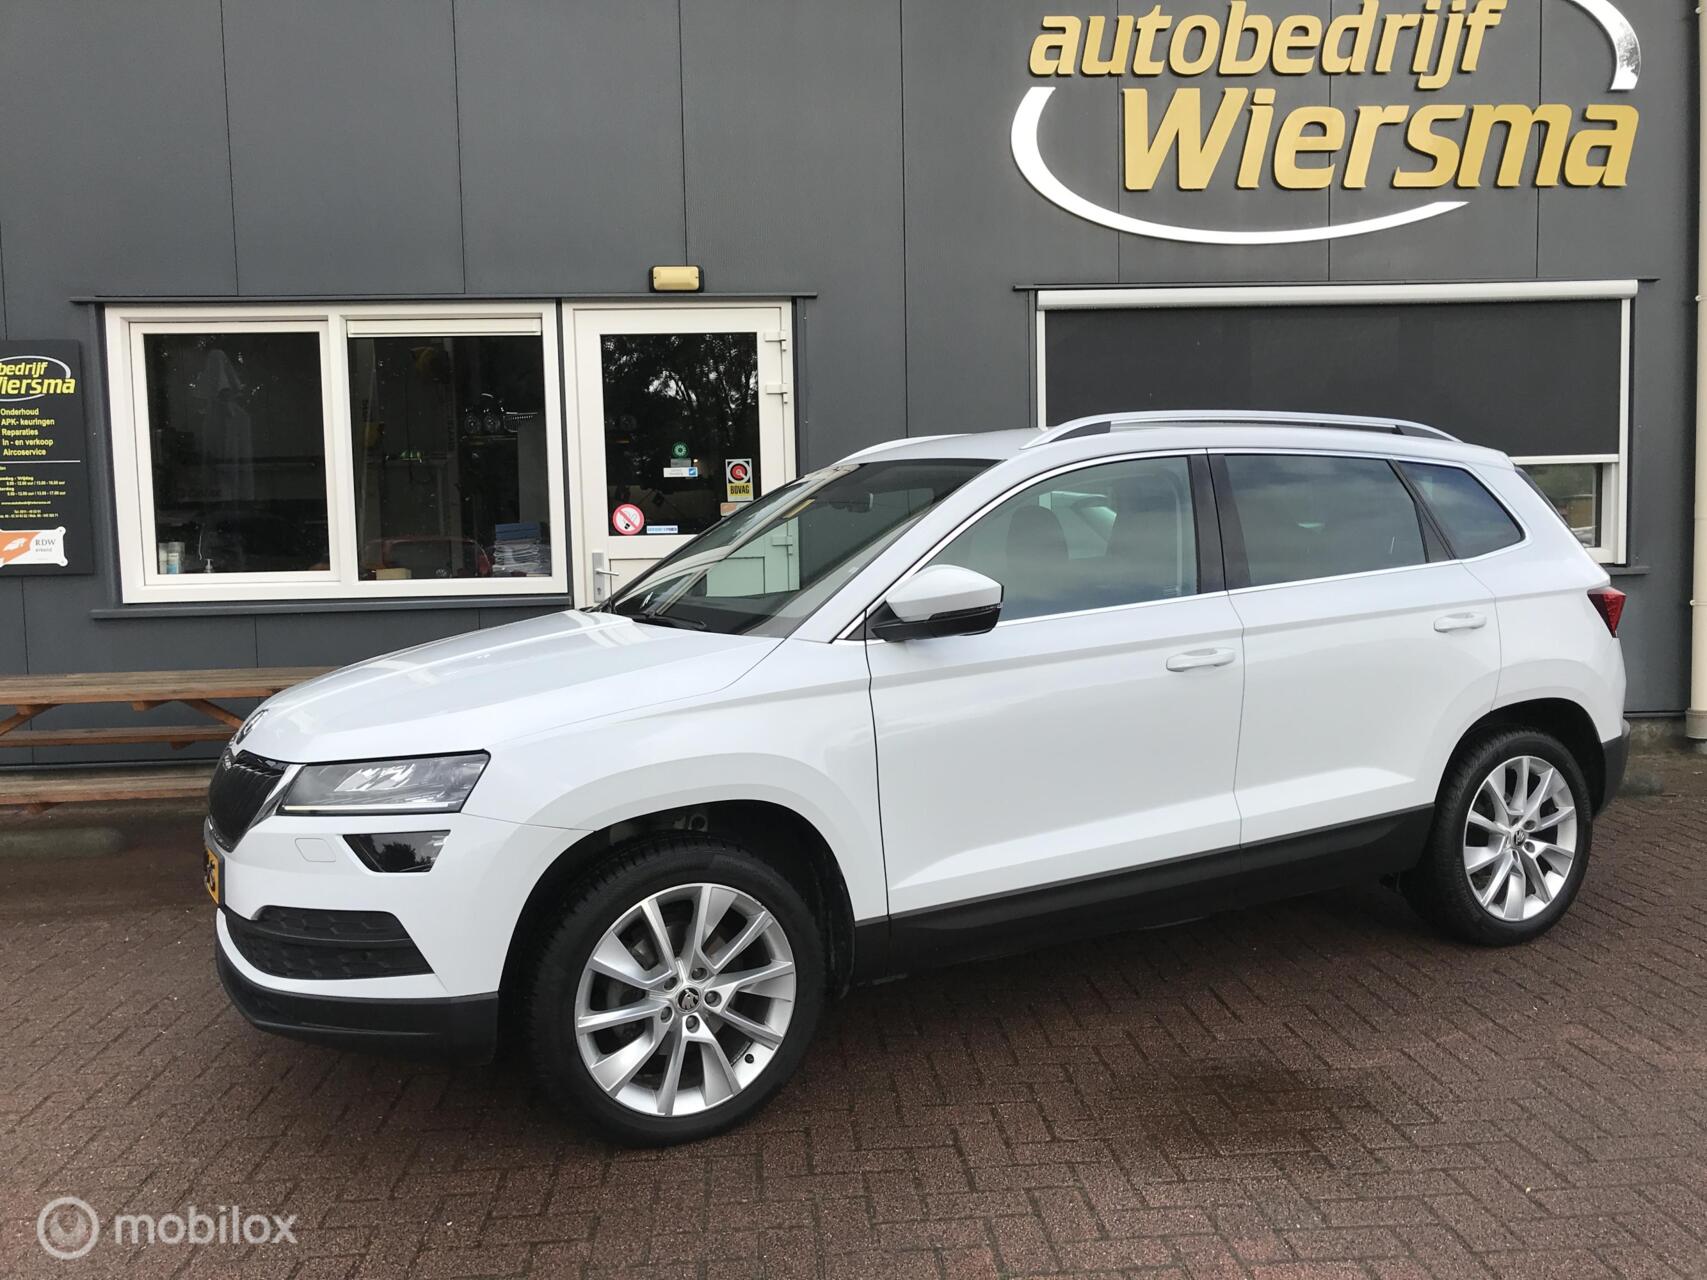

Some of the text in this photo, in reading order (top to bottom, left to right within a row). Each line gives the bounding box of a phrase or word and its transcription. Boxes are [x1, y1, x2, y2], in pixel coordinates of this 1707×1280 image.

[1028, 0, 1507, 90] autobedrijf
[1121, 87, 1641, 191] Wiersma
[0, 408, 39, 416] Onderhoud
[20, 418, 55, 427] keuringen
[1, 428, 39, 438] Reparaties
[2, 438, 10, 446] In
[25, 438, 54, 447] verkoop
[3, 448, 47, 456] Aircoservice
[730, 485, 750, 495] BOVAG
